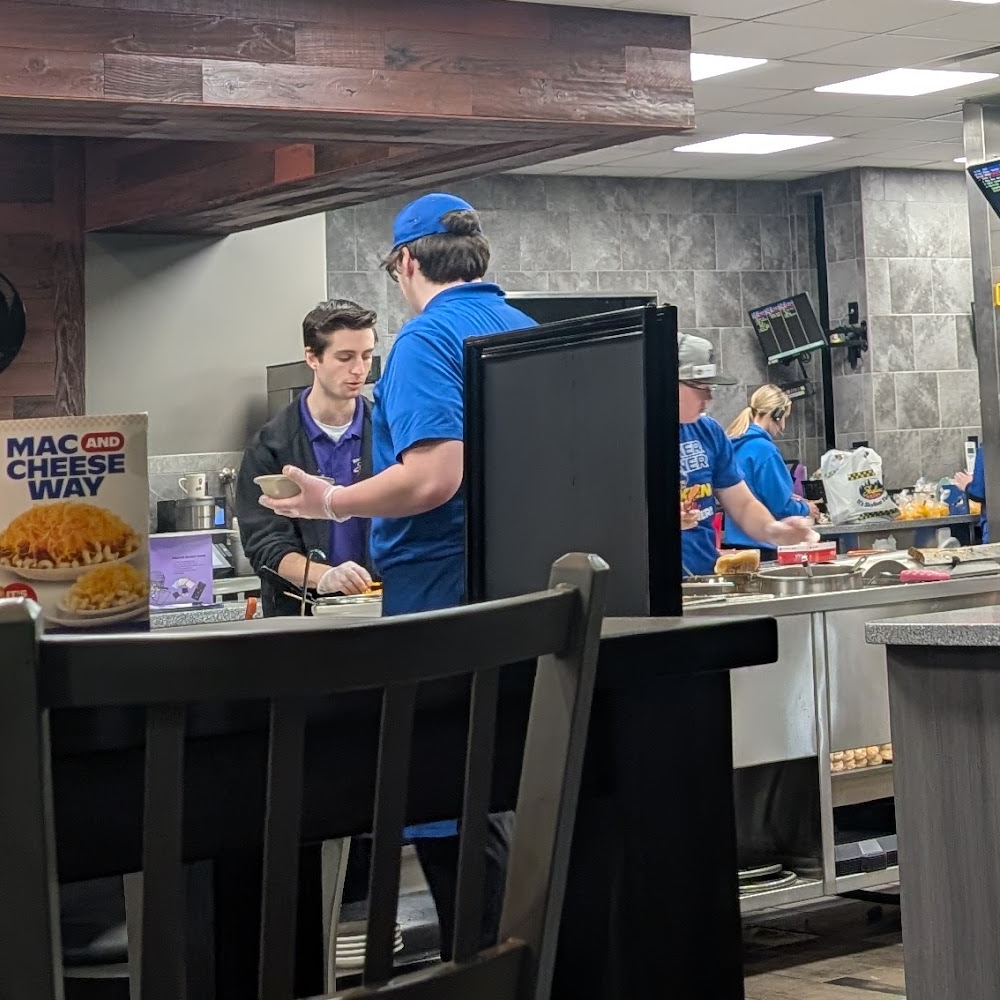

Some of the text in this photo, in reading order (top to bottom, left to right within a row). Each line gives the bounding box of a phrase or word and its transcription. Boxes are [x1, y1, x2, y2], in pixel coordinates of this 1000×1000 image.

[7, 434, 120, 458] MAC AND
[6, 453, 126, 480] CHEESE
[28, 476, 104, 501] WAY
